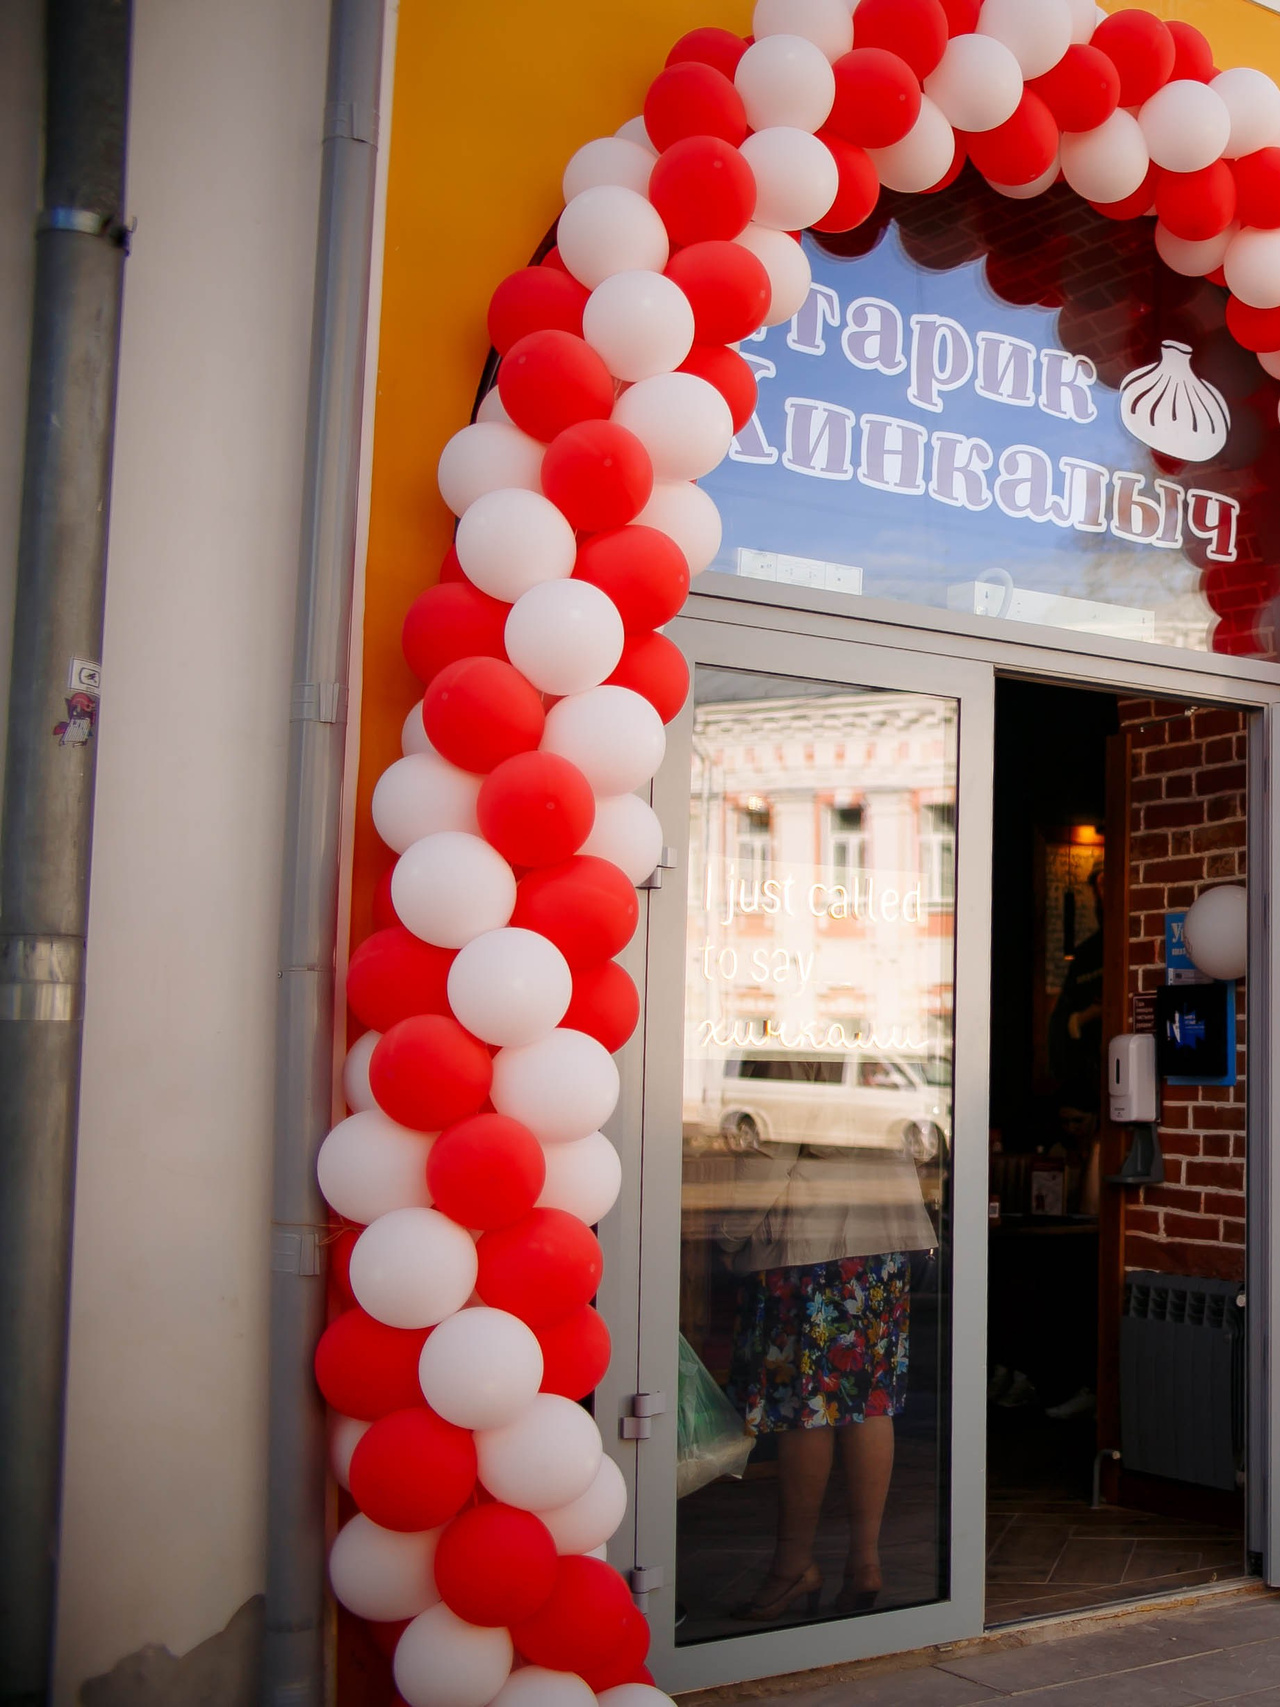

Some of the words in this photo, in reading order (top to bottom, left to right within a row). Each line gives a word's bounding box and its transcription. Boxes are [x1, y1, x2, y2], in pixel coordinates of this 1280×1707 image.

[740, 281, 1098, 425] тарик
[720, 863, 796, 927] just
[808, 876, 922, 924] called
[699, 934, 739, 983] to
[749, 947, 815, 998] say
